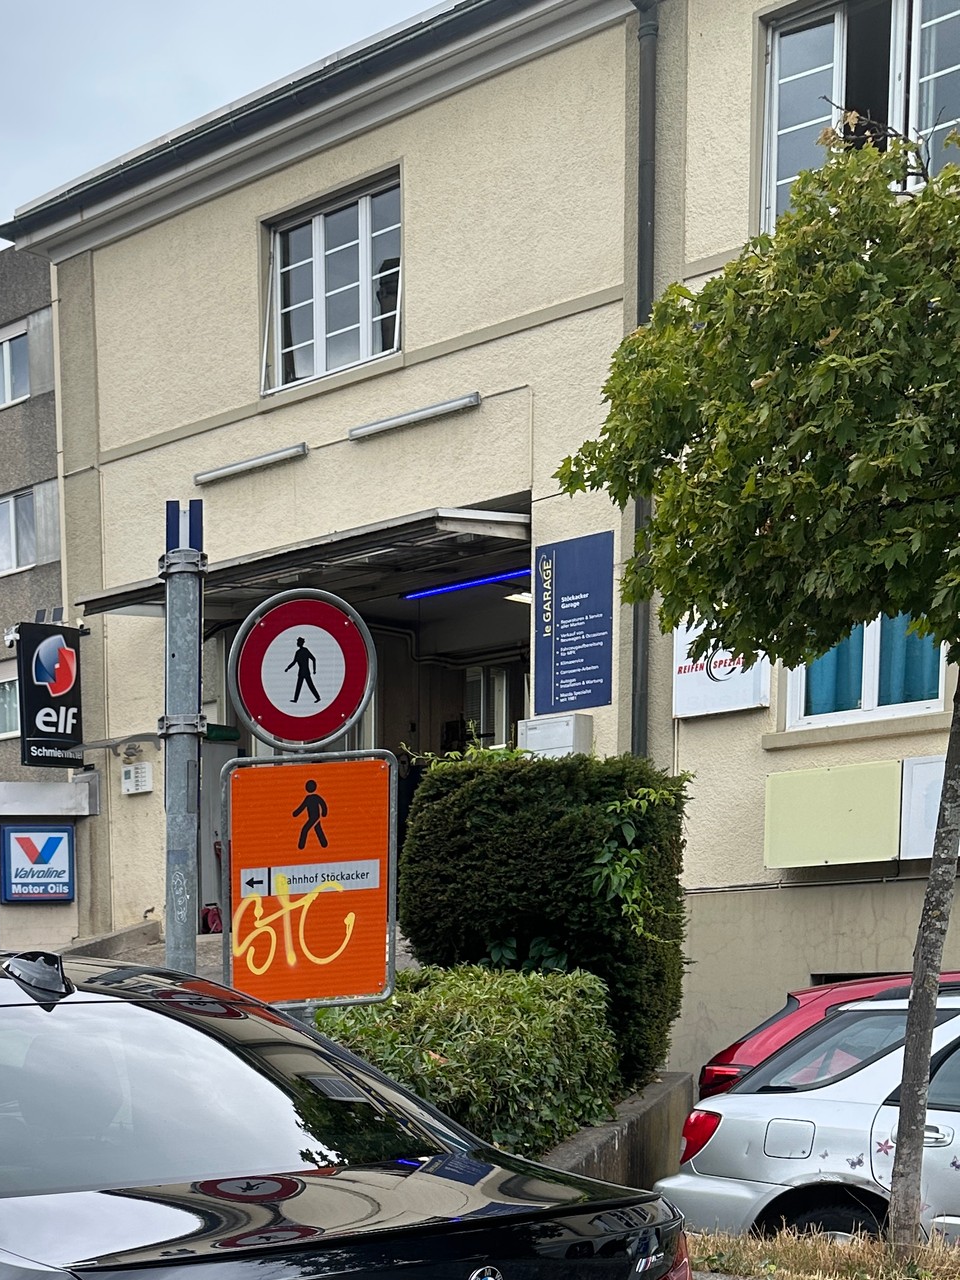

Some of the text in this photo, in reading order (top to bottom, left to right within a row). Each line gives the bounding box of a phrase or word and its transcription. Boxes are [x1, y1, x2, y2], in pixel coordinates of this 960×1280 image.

[543, 559, 552, 637] le GARAGE
[561, 601, 580, 609] Garage
[677, 662, 705, 675] REIFEN
[35, 706, 78, 734] elf
[14, 867, 66, 879] Valvoline
[321, 870, 370, 883] Stöckacker
[11, 883, 69, 894] Motor Oils
